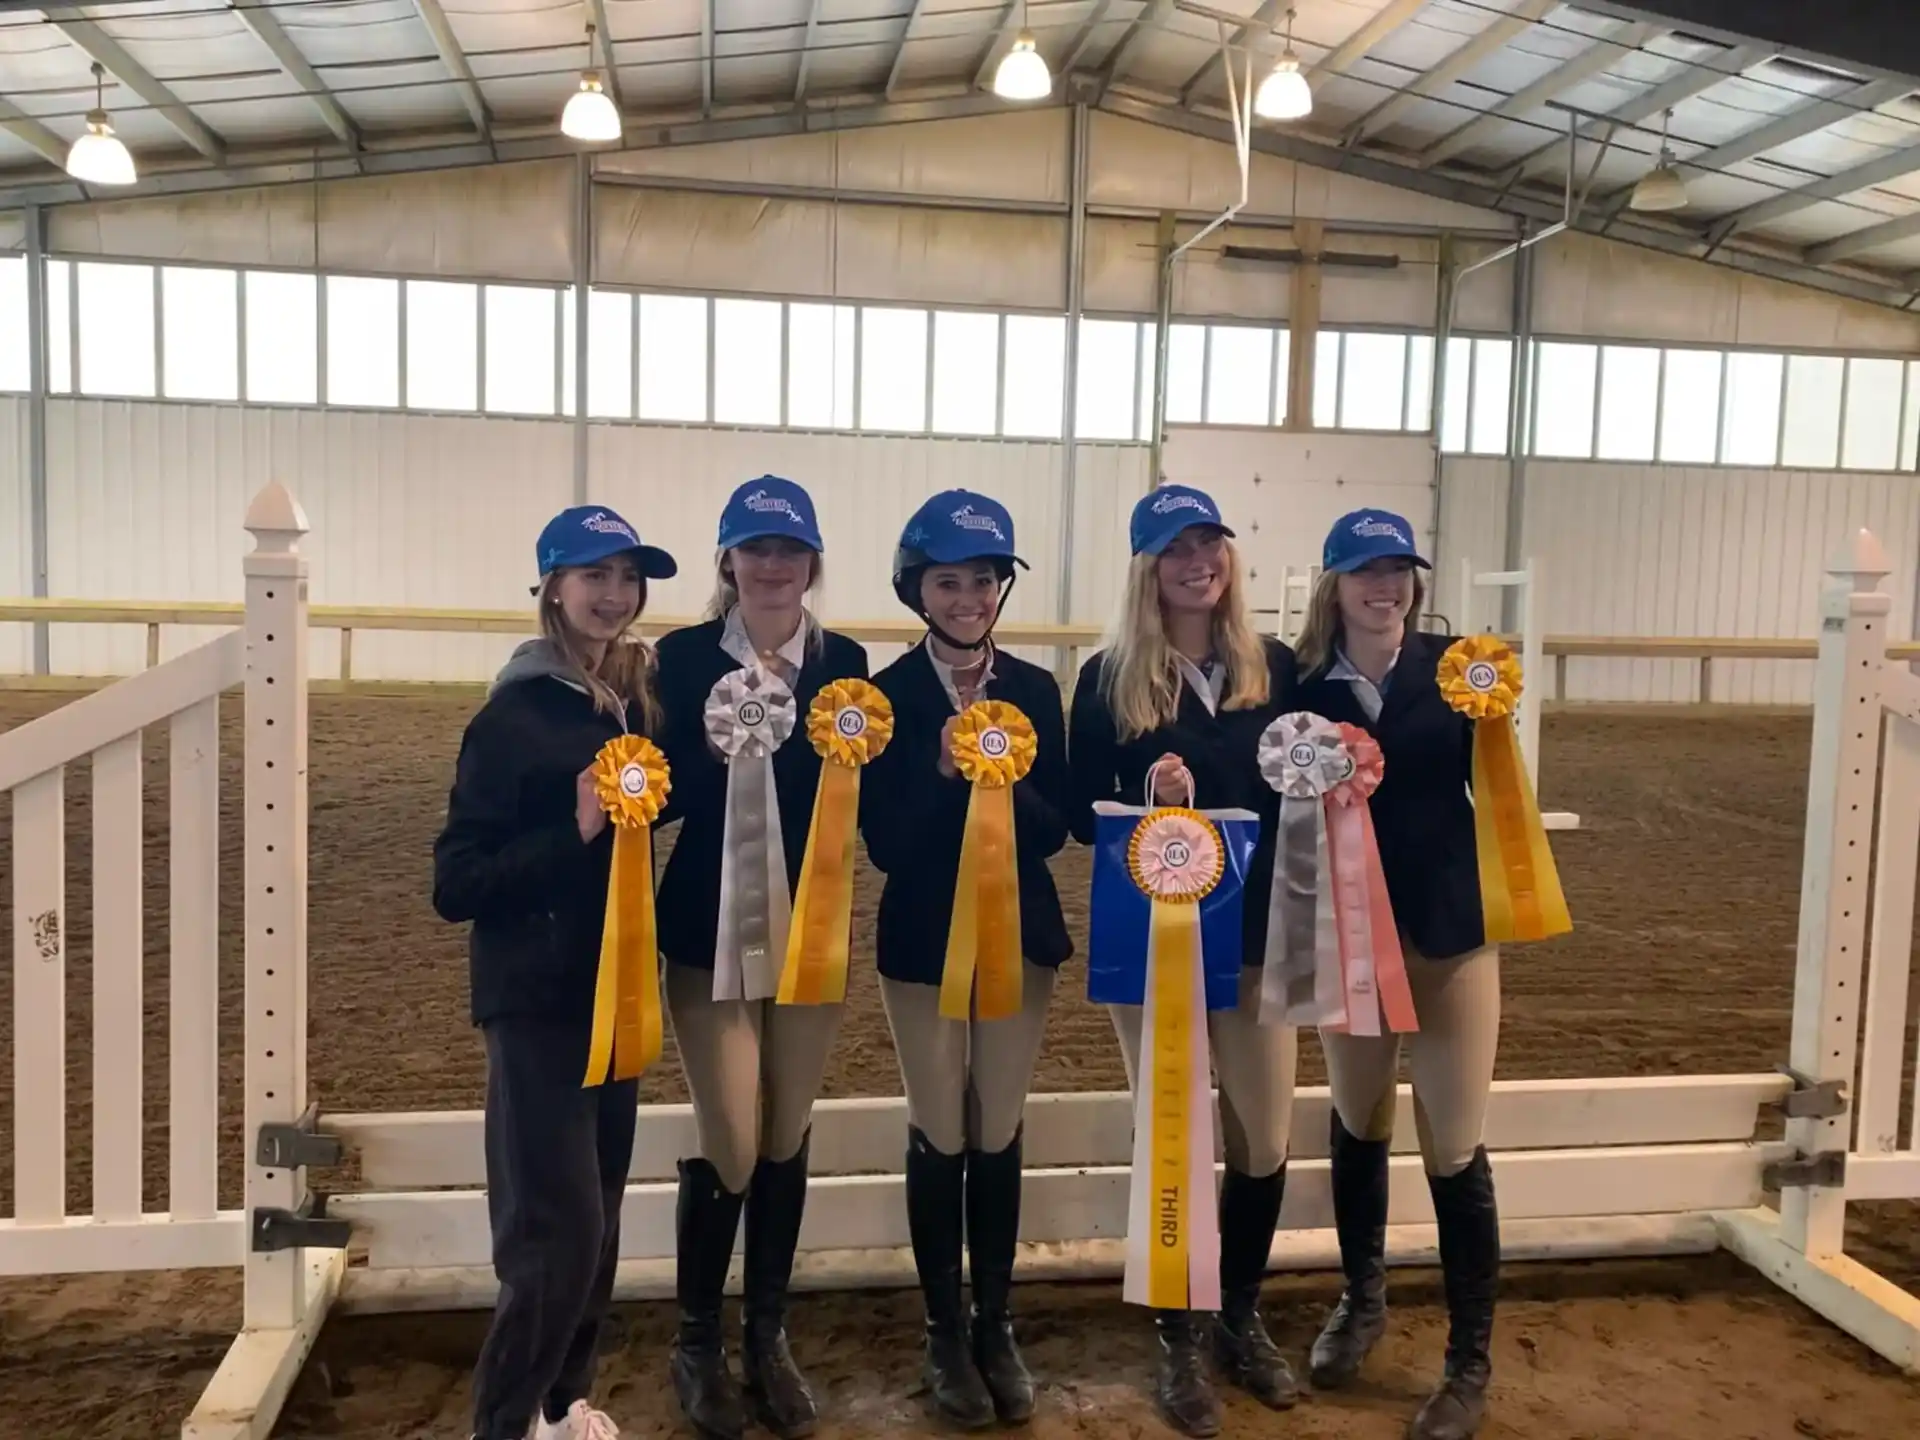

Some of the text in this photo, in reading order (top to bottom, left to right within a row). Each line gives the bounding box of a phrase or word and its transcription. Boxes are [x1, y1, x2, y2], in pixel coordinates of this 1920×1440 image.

[743, 709, 760, 718] IEA
[843, 716, 858, 729] IEA
[986, 738, 1002, 748] IEA
[1295, 750, 1310, 760] IEA
[1169, 849, 1185, 859] IEA
[1161, 1185, 1178, 1248] THIRD
